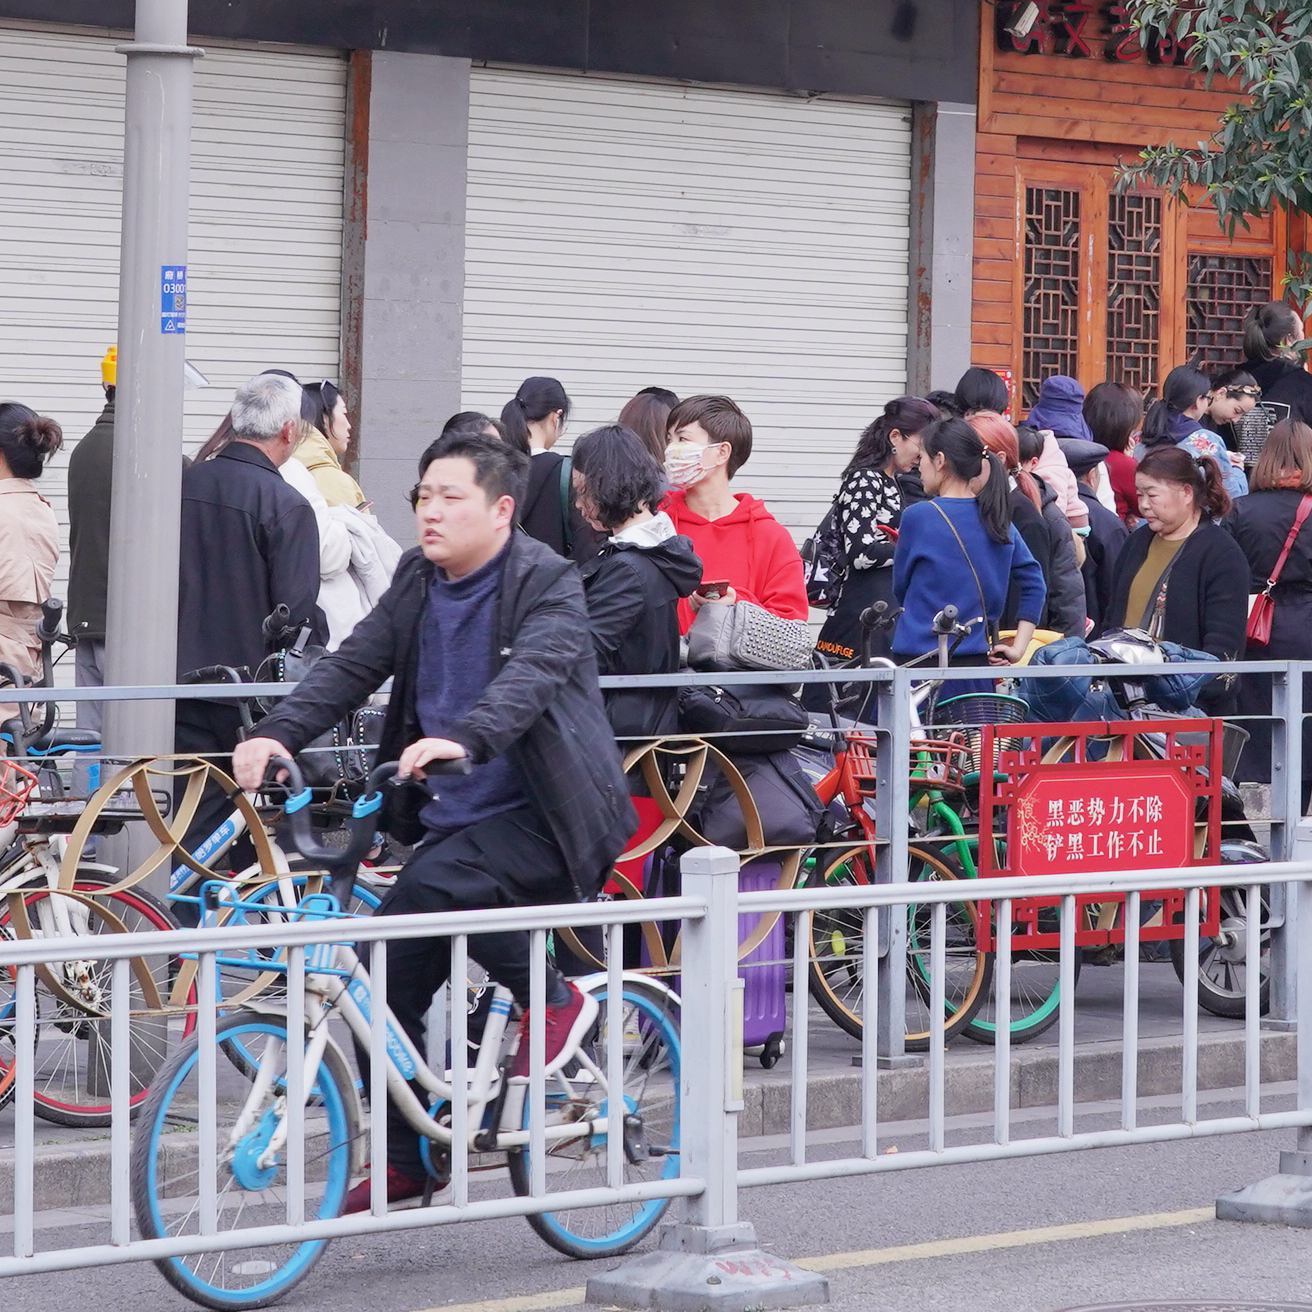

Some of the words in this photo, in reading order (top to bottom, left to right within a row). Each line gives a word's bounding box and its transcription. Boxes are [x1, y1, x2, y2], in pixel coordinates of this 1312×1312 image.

[1046, 794, 1164, 828] 黑恶势力不除
[1045, 828, 1164, 862] 铲黑工作不止
